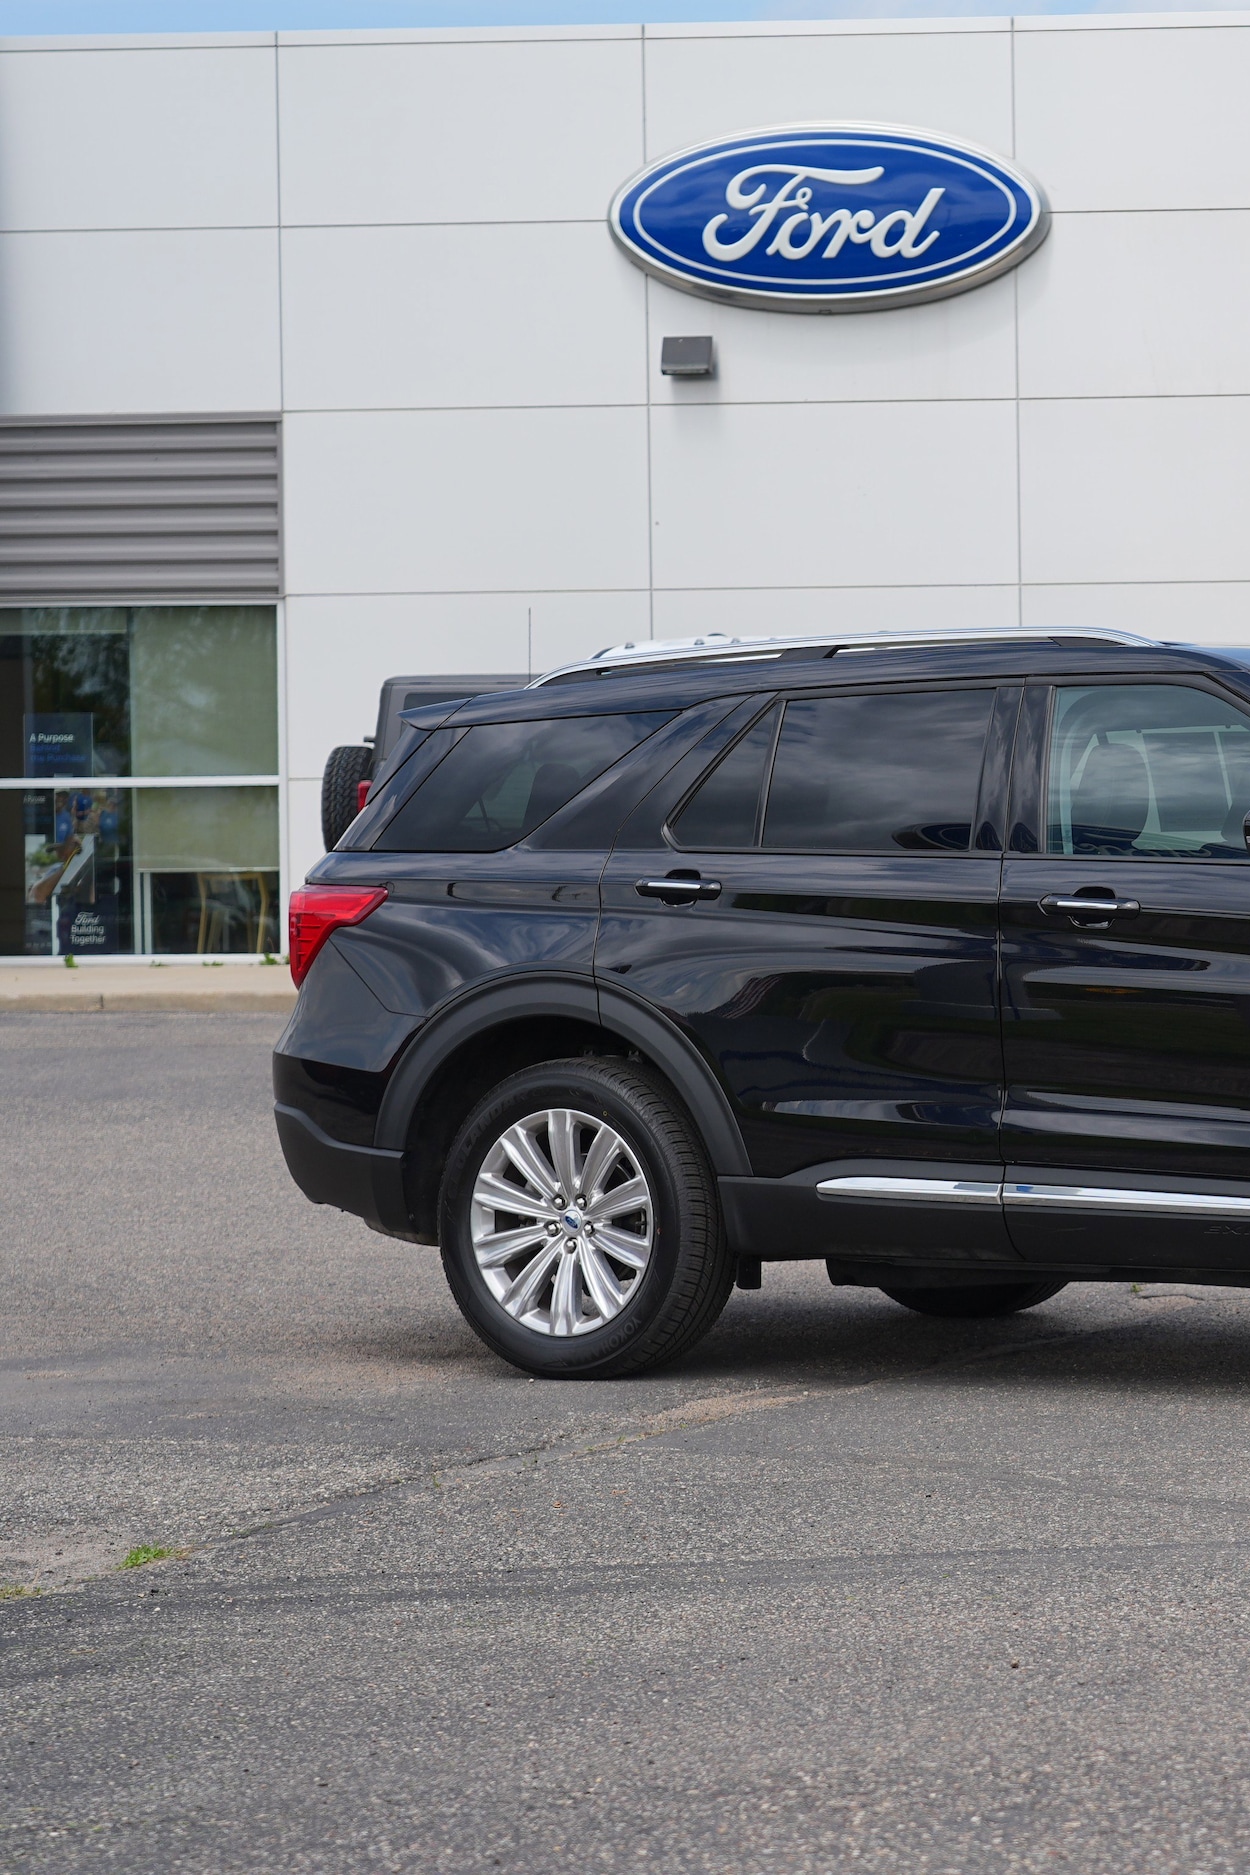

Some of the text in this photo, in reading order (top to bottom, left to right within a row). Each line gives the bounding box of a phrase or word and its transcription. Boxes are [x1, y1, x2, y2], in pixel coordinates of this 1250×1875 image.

[702, 163, 946, 261] Ford
[29, 733, 74, 743] A Purpose
[75, 911, 100, 925] Ford
[71, 925, 104, 935] Building
[70, 935, 106, 946] Together
